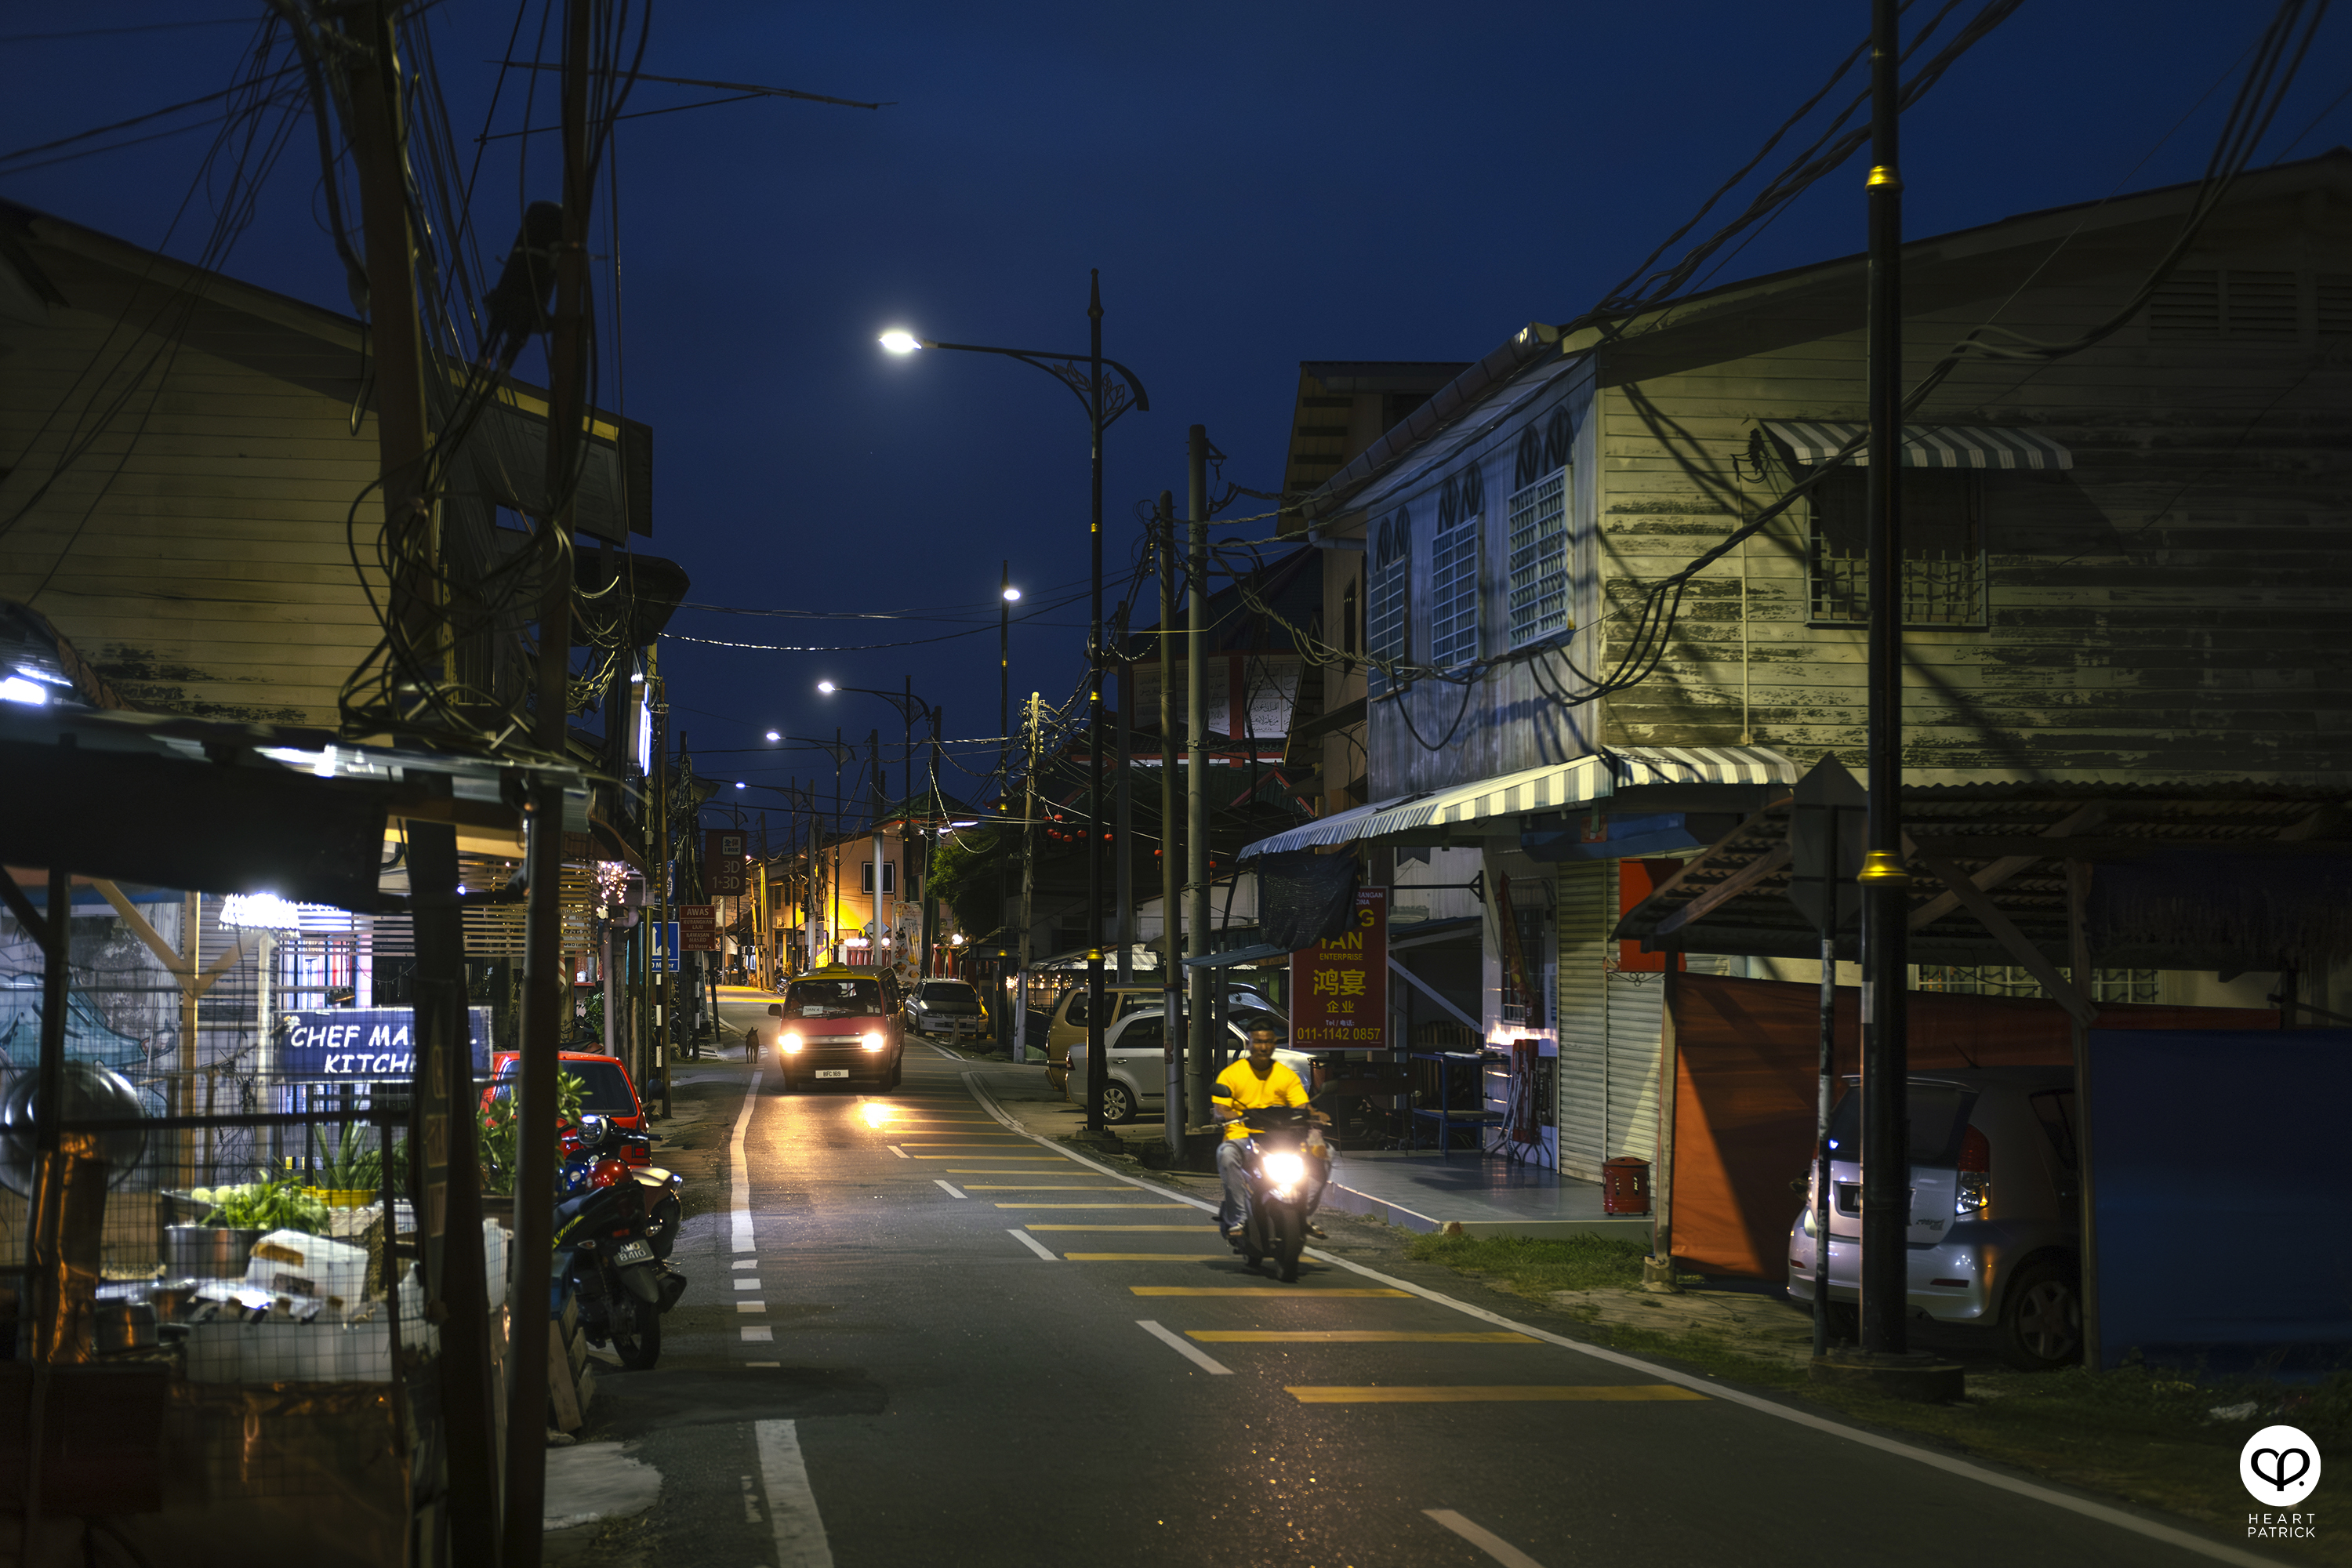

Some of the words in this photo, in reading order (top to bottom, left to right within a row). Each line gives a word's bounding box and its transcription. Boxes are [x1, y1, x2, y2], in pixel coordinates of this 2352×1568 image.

[723, 860, 740, 874] 3D
[712, 876, 740, 889] 1+3D
[1313, 968, 1366, 996] 鸿宴
[1327, 1000, 1355, 1013] 企业
[290, 1025, 361, 1048] CHEF
[1297, 1027, 1349, 1040] 011-1142
[1353, 1028, 1381, 1040] 0857
[324, 1053, 417, 1074] KITCH
